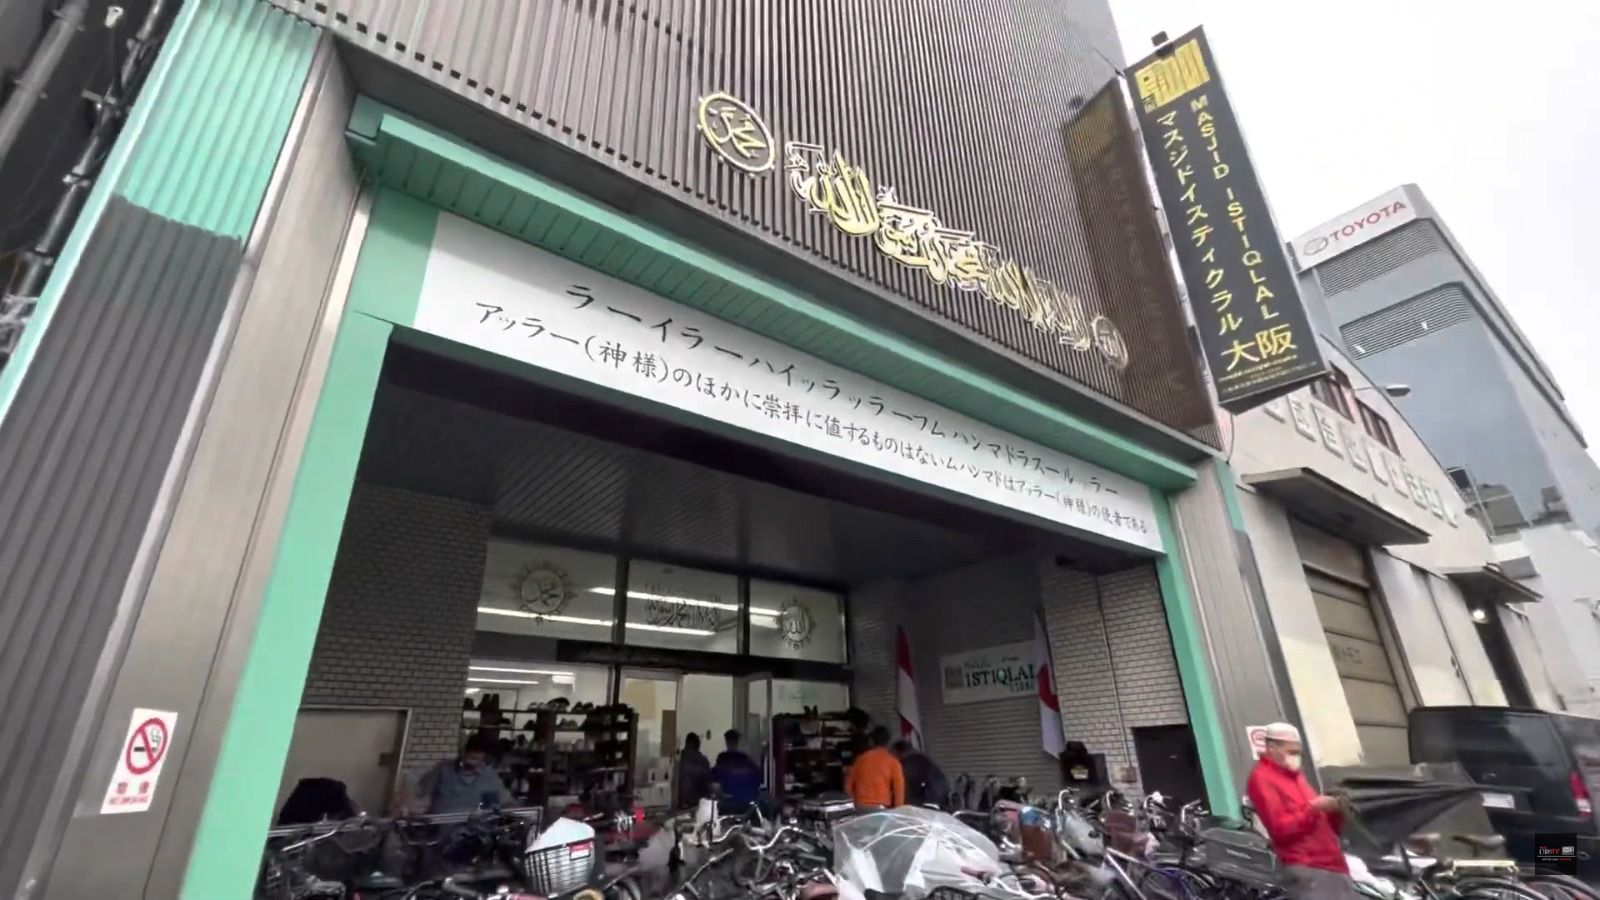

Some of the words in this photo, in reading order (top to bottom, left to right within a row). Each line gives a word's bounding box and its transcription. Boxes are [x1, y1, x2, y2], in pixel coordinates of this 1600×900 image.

[1157, 110, 1243, 336] マスジドイスティクラル
[1190, 95, 1230, 180] MASJID
[1226, 187, 1280, 320] ISTIQLAL
[1328, 200, 1407, 243] TOYOTA
[1220, 323, 1298, 372] 大阪
